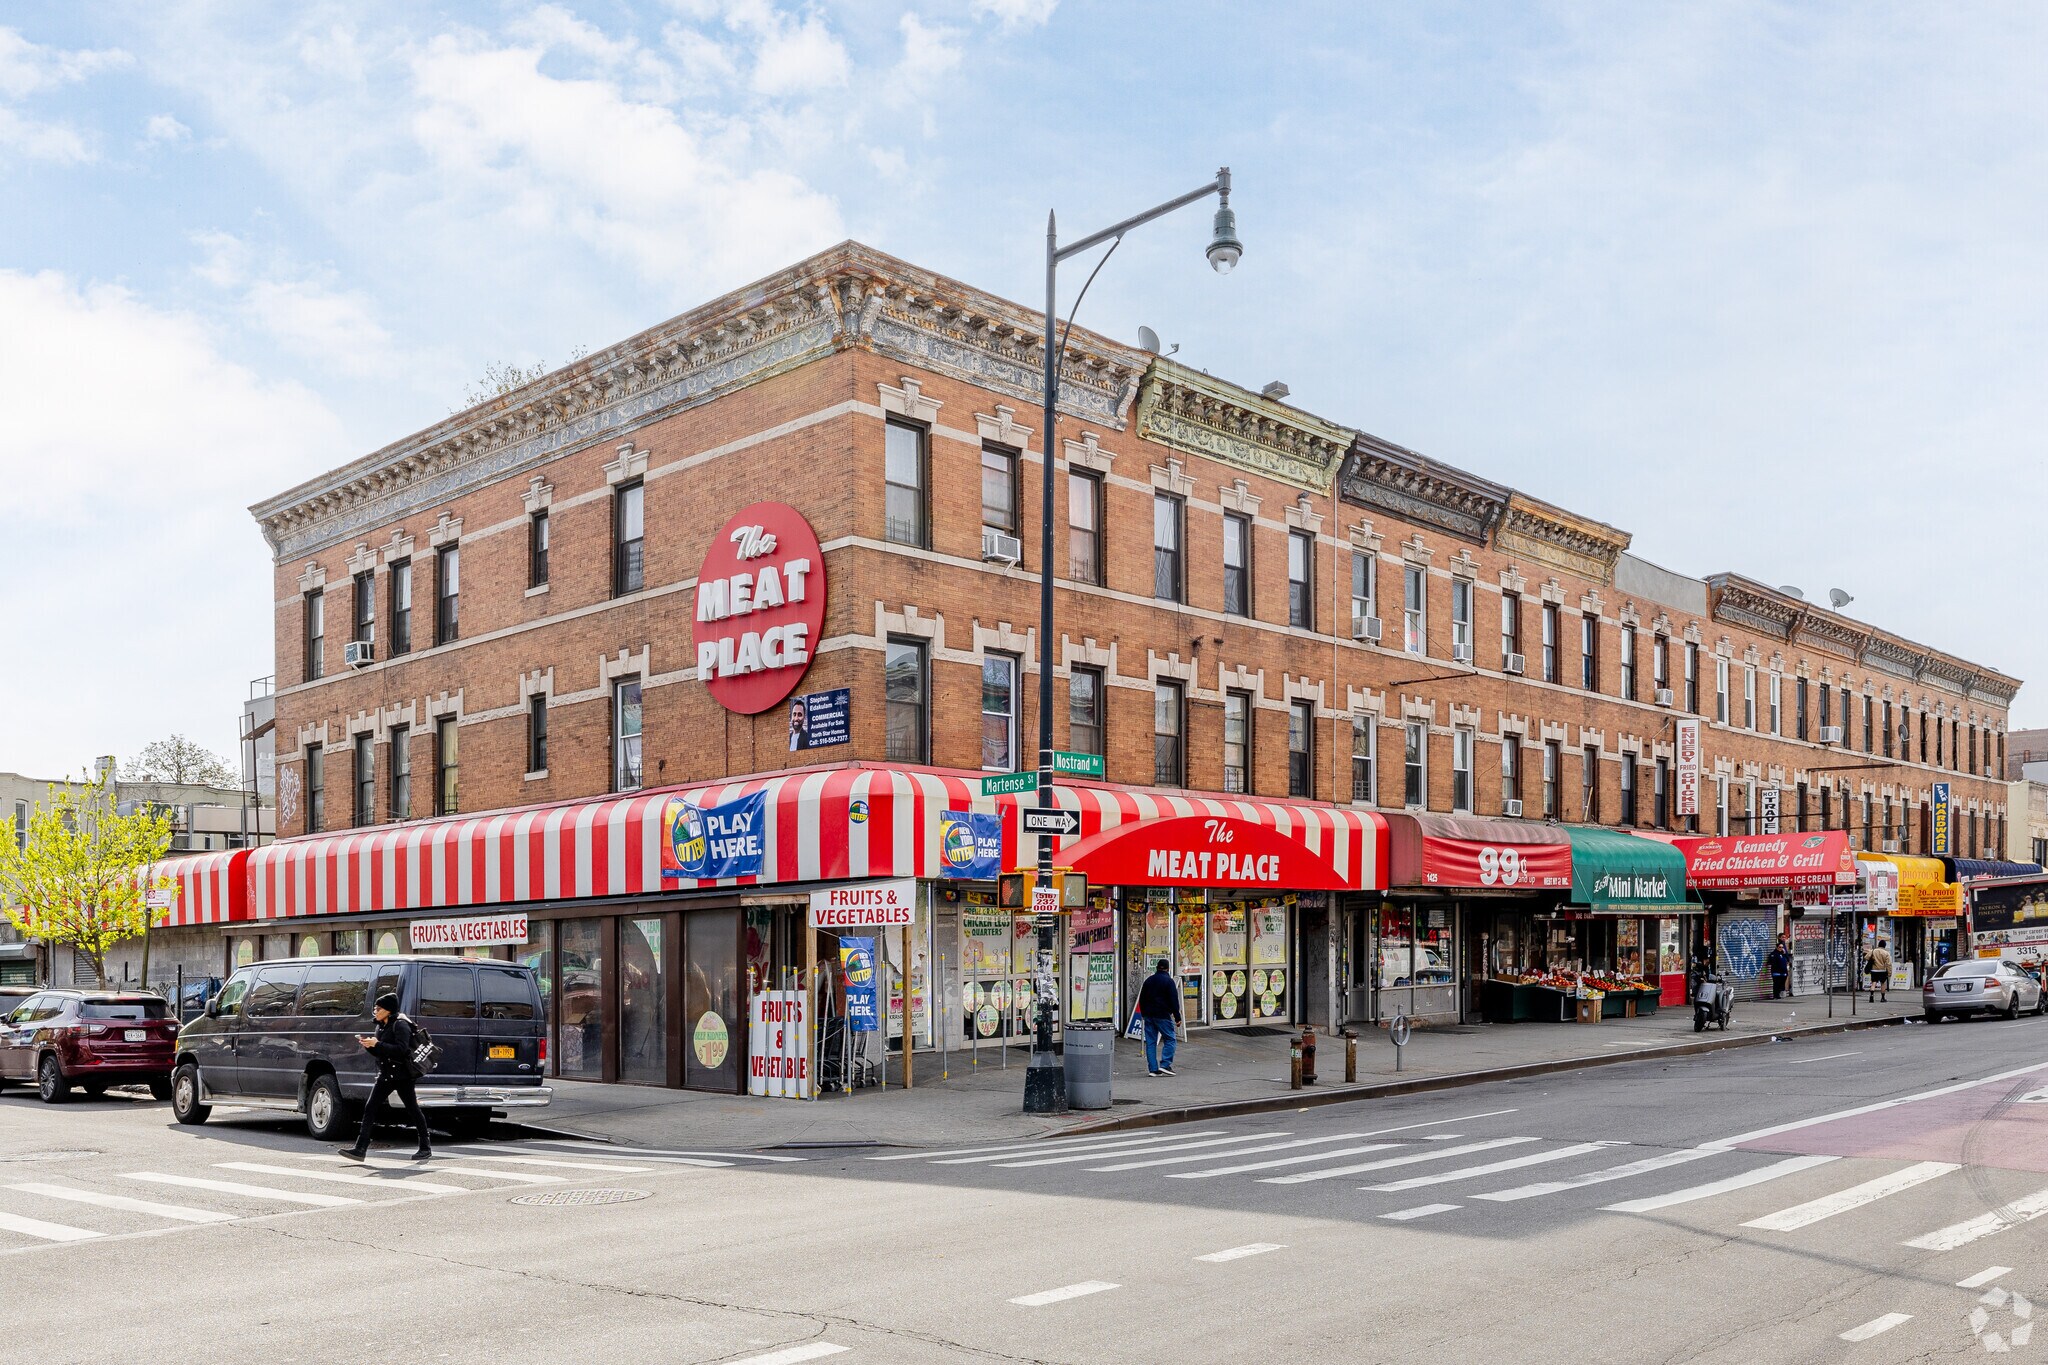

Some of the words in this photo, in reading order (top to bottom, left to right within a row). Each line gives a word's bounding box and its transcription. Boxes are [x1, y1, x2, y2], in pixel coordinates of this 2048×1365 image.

[730, 525, 777, 560] The
[697, 558, 810, 622] MEAT
[698, 622, 808, 681] PLACE
[812, 711, 844, 722] COMMERCIAL
[811, 722, 828, 730] Available
[1056, 756, 1090, 771] Nostrand
[1092, 758, 1099, 767] Av
[986, 778, 1024, 793] Martense
[1028, 774, 1034, 784] St
[1682, 772, 1695, 813] CHICKEN
[706, 811, 754, 836] PLAY
[1031, 816, 1048, 826] ONE
[1054, 817, 1072, 828] WAY
[1935, 803, 1947, 851] HARDWARE
[1204, 820, 1234, 844] The
[710, 836, 762, 860] HERE.
[978, 838, 998, 847] PLAY
[1734, 838, 1788, 855] Kennedy
[1148, 849, 1211, 879] MEAT
[1216, 853, 1280, 881] PLACE
[1692, 858, 1724, 871] Fried
[1726, 855, 1776, 870] Chicken
[1777, 852, 1790, 868] &
[1793, 852, 1825, 868] Grill
[1427, 873, 1438, 882] 1425
[1529, 877, 1536, 885] up
[1686, 879, 1698, 887] ISH
[1702, 878, 1715, 886] HOT
[1716, 876, 1739, 886] WINGS
[1744, 876, 1788, 885] SANDWICHES
[1794, 875, 1806, 884] ICE
[1807, 874, 1832, 884] CREAM
[1608, 877, 1630, 898] Mini
[1634, 876, 1667, 898] Market
[1760, 889, 1784, 899] ATM
[830, 889, 882, 906] FRUITS
[886, 889, 898, 904] &
[816, 907, 910, 925] VEGETABLES
[412, 924, 448, 943] FRUITS
[450, 924, 458, 942] &
[459, 919, 527, 940] VEGETABLES
[972, 928, 1002, 936] QUARTERS
[1266, 924, 1282, 932] GOAT
[2016, 946, 2038, 955] 3315
[1090, 955, 1112, 964] WHOLE
[1090, 963, 1112, 973] MILK
[1089, 972, 1112, 982] GALLON
[846, 994, 870, 1004] PLAY
[762, 1000, 802, 1022] FRUTS
